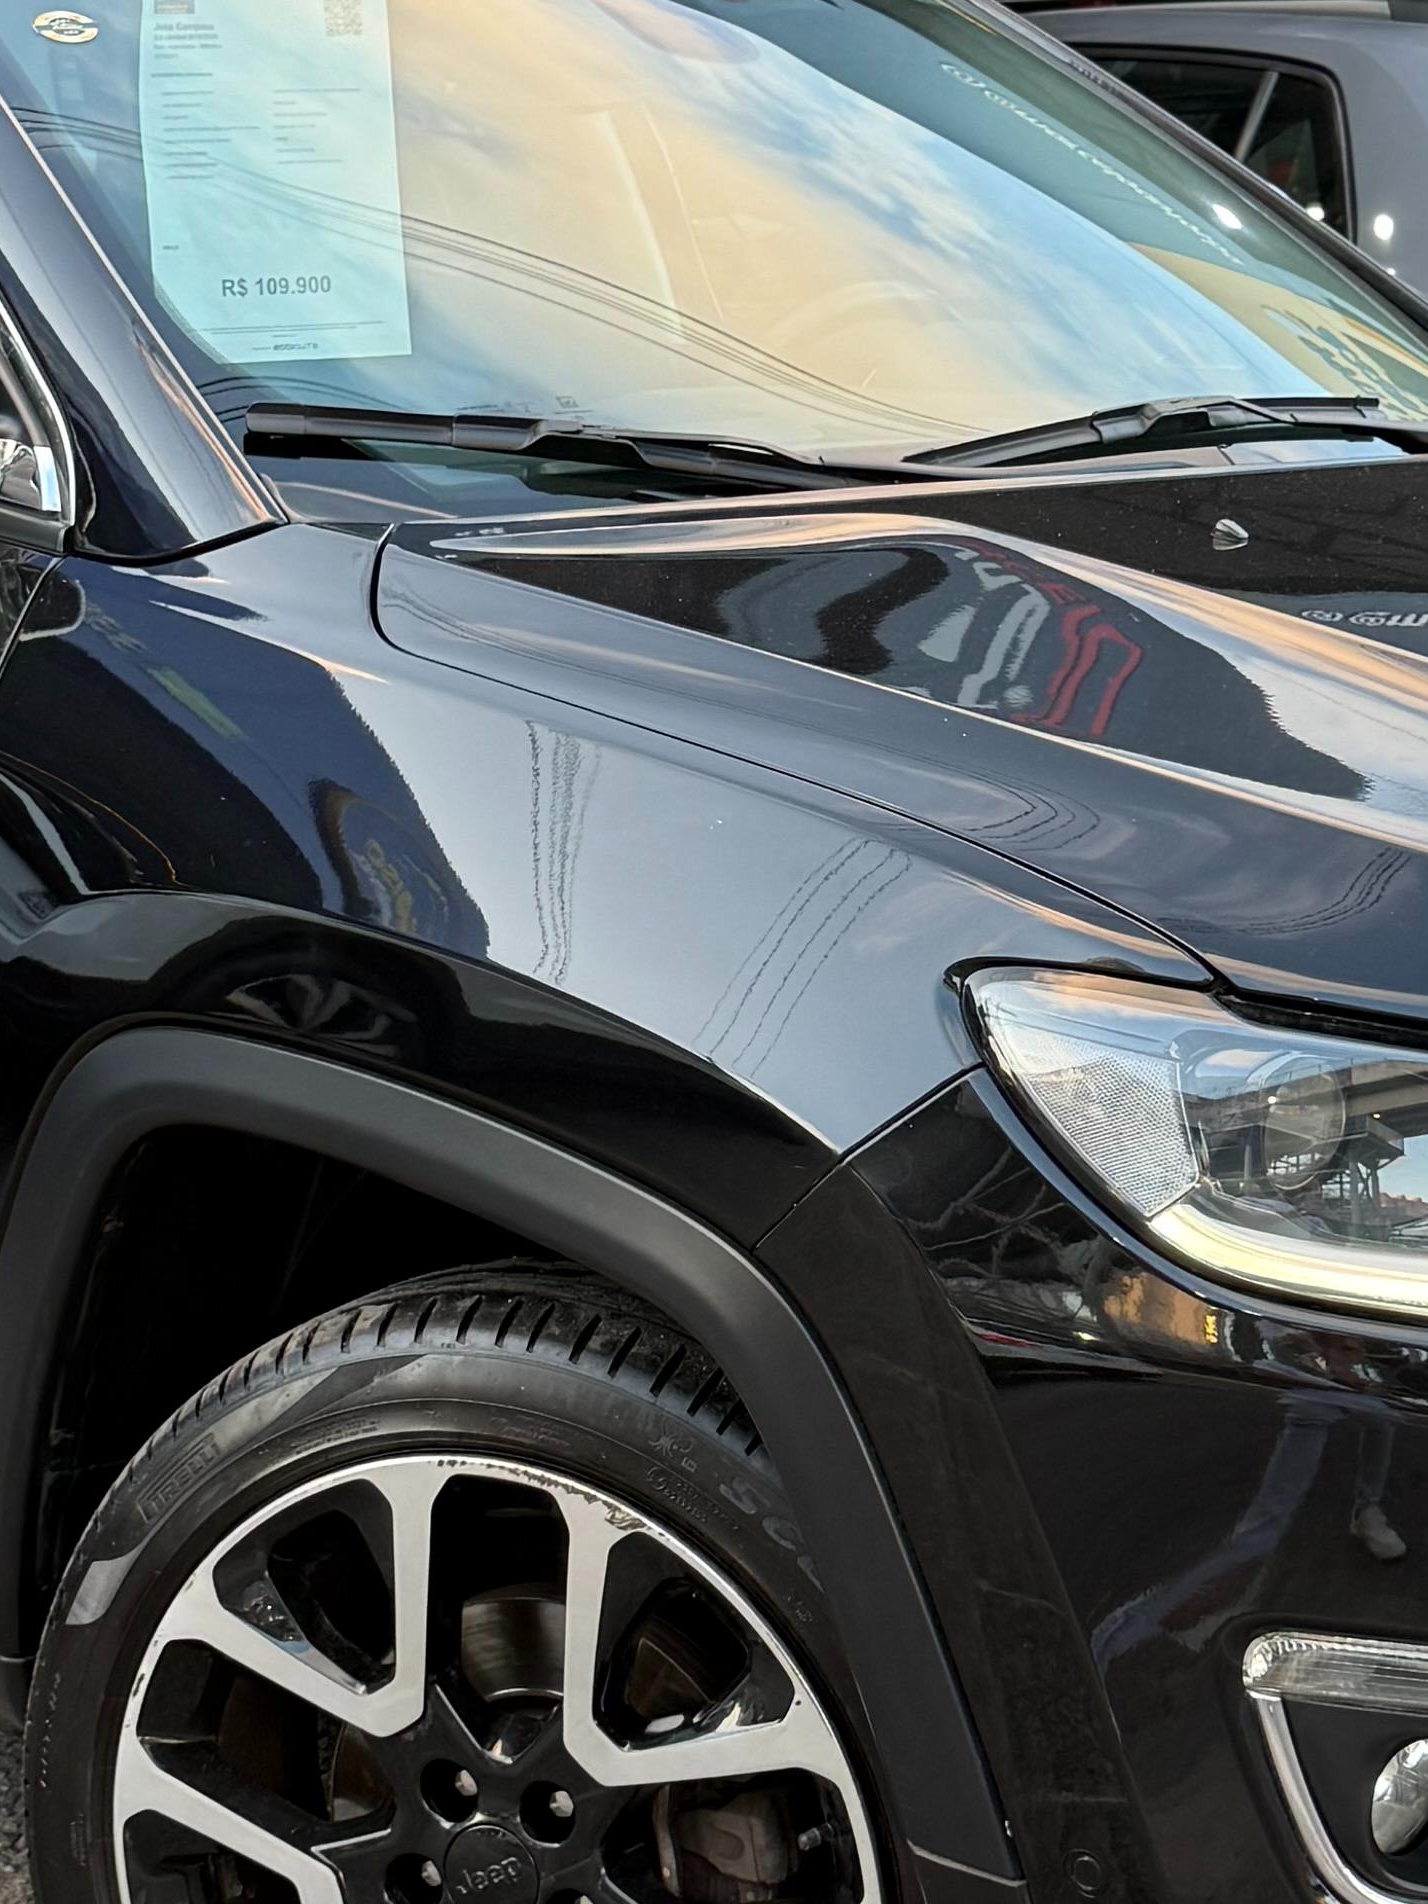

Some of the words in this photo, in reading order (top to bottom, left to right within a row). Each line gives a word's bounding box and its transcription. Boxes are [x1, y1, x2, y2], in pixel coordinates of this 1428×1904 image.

[221, 279, 248, 298] R$
[255, 275, 332, 296] 109.900
[456, 1856, 522, 1895] Jeep
